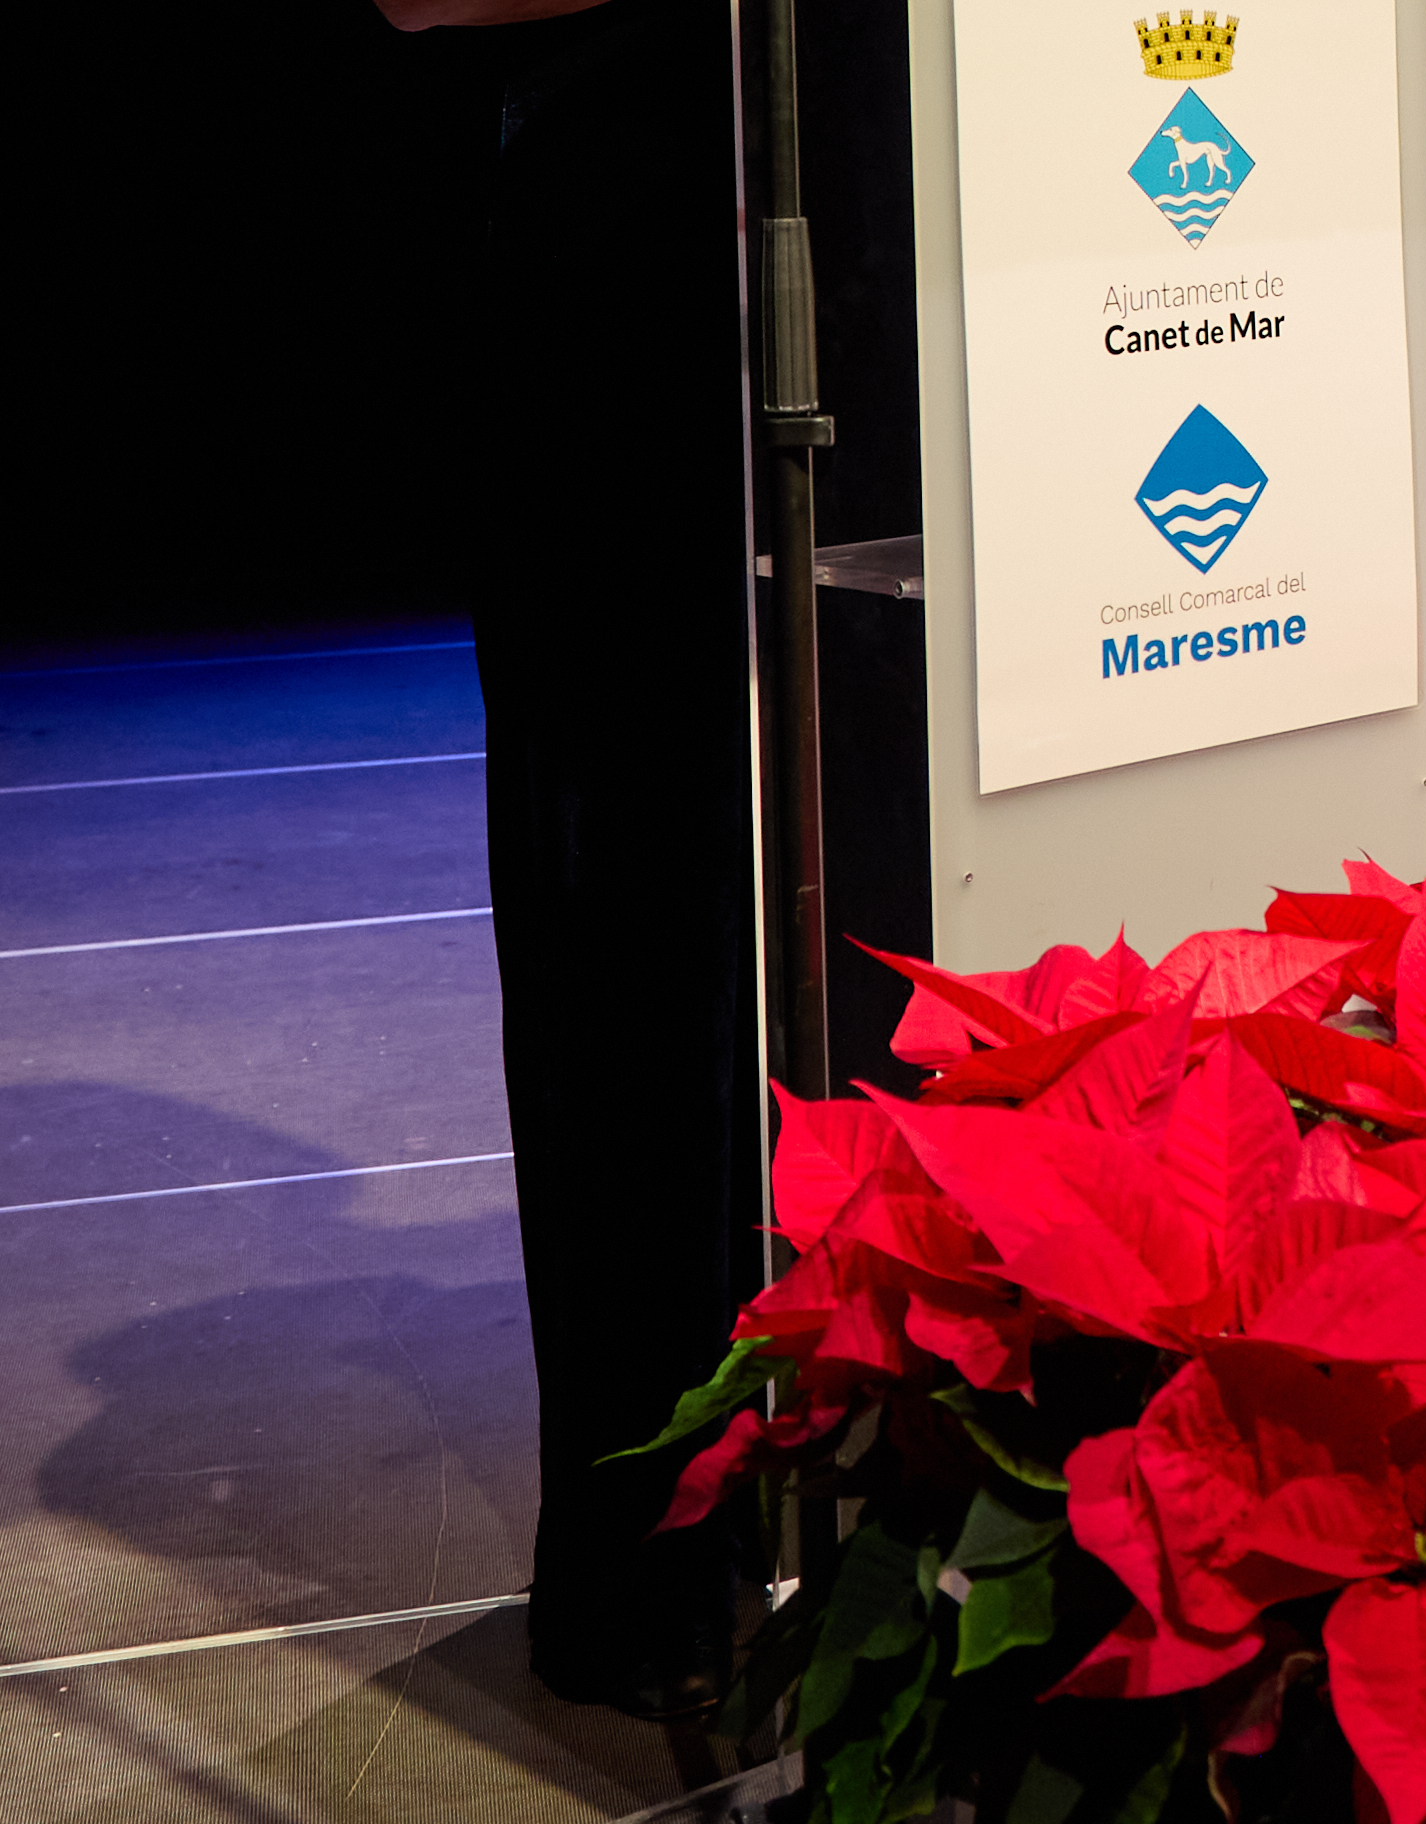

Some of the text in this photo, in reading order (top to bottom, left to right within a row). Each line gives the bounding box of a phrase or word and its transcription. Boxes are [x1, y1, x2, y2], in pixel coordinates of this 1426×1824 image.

[1102, 270, 1284, 320] Ajuntament de
[1104, 310, 1285, 356] Canet de Mar
[1099, 571, 1307, 626] Consell Comarcal del
[1102, 614, 1307, 679] Maresme
